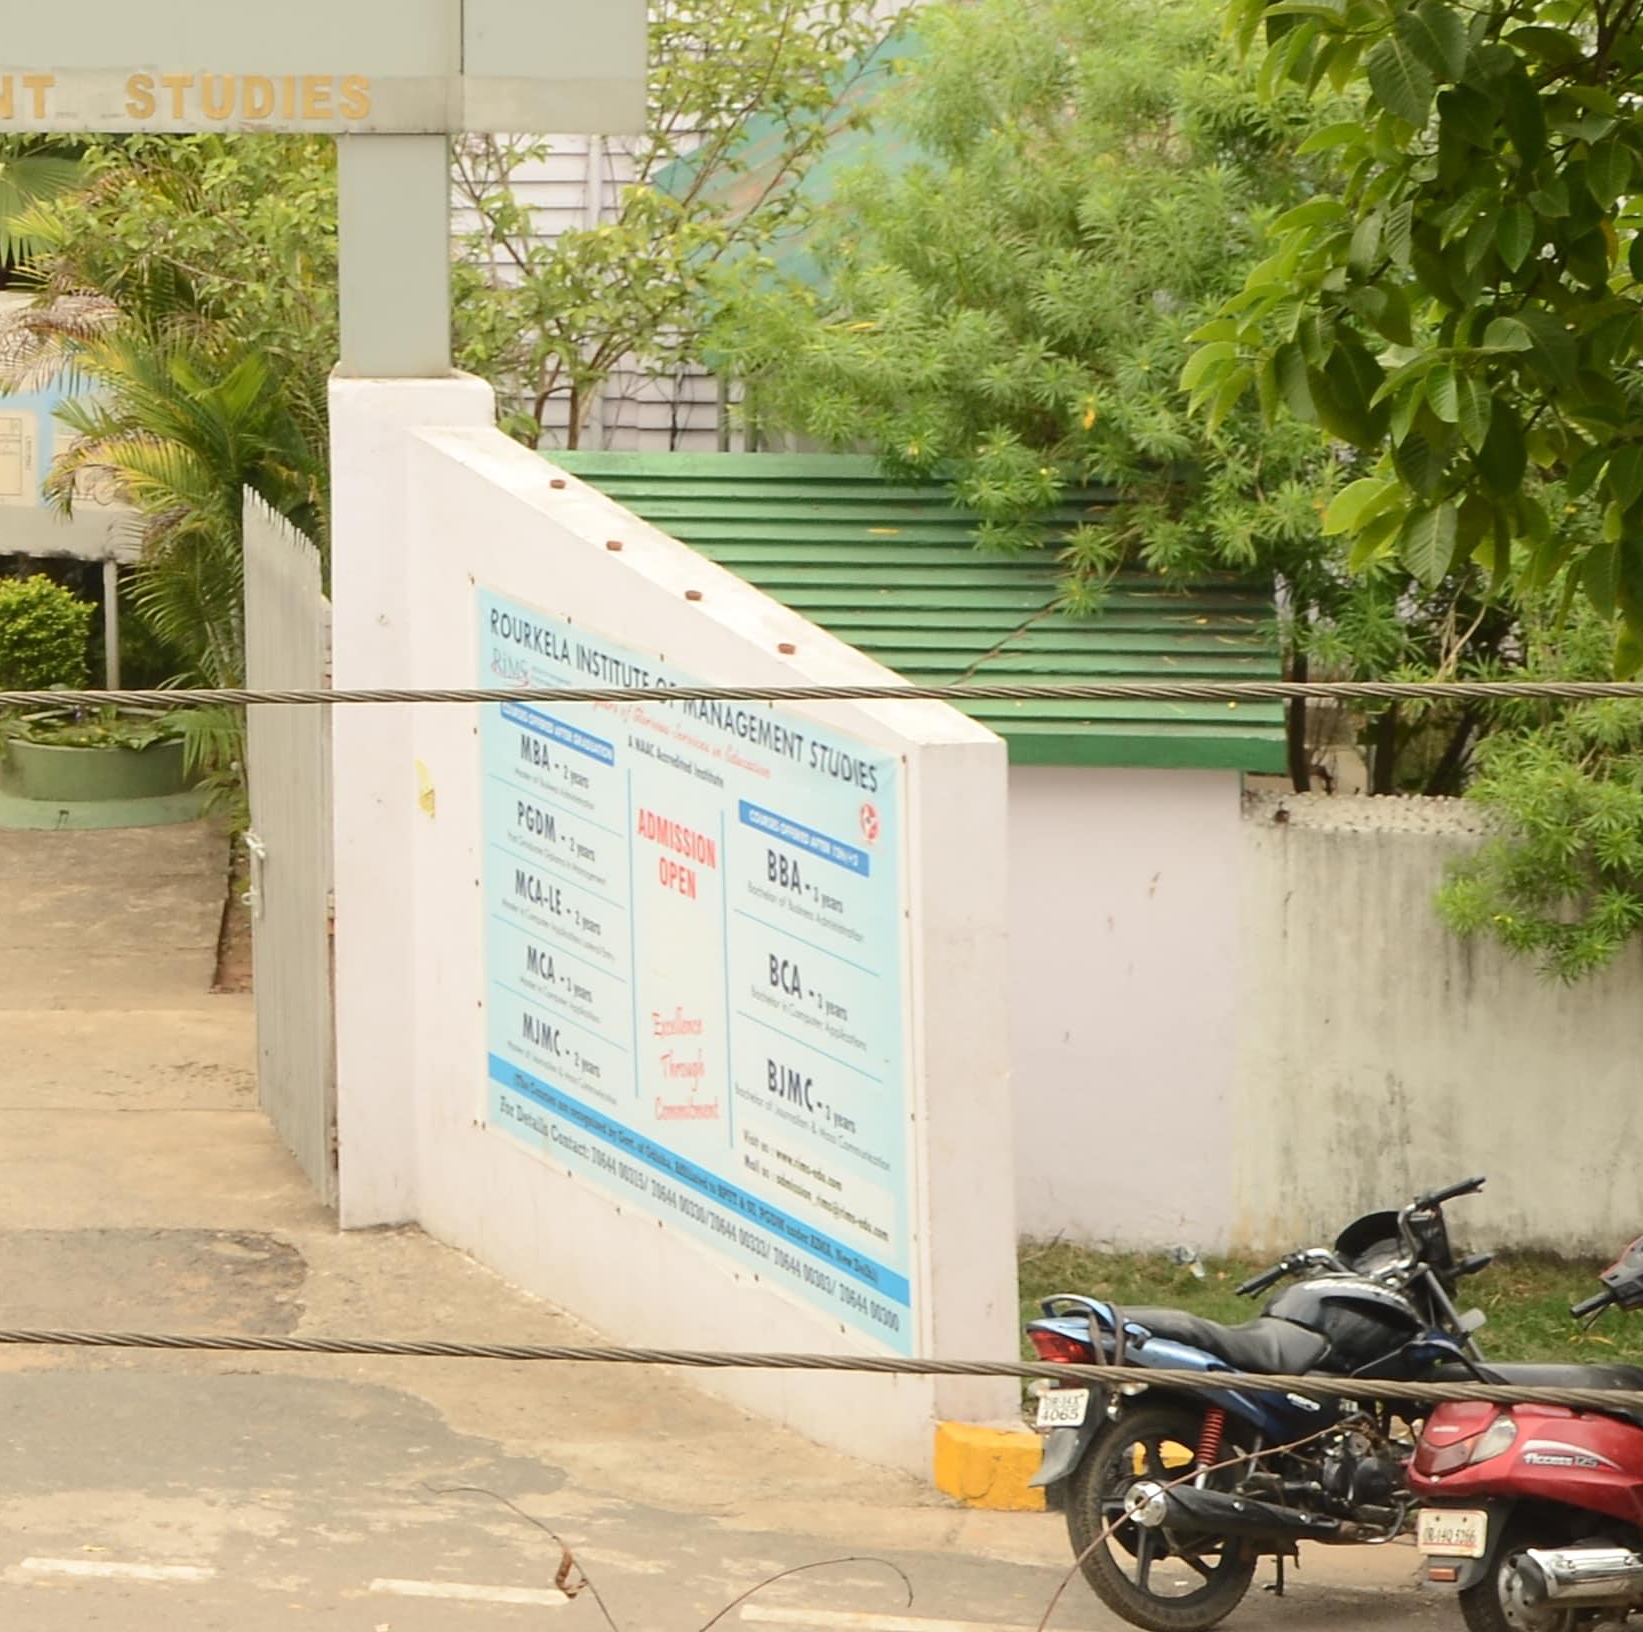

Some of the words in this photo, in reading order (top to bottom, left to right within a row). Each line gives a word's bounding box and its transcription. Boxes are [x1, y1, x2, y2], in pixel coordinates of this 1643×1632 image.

[123, 73, 374, 122] STUDIES
[490, 607, 572, 666] ROURKELA
[575, 642, 650, 692] INSTITUTE
[683, 697, 804, 763] MANAGEMENT
[808, 740, 879, 794] STUDIES
[520, 733, 550, 771] MBA
[517, 799, 556, 843] PGDM
[637, 807, 716, 870] ADMISSION
[515, 868, 563, 917] MCA-LE
[659, 856, 696, 901] OPEN
[767, 848, 803, 895] BBA
[526, 945, 556, 984] MCA
[769, 952, 803, 1000] BCA
[522, 1011, 562, 1058] MJMC
[766, 1058, 814, 1113] BJMC
[1041, 1408, 1080, 1421] 4065
[1523, 1451, 1573, 1466] Access
[1574, 1454, 1600, 1468] 125
